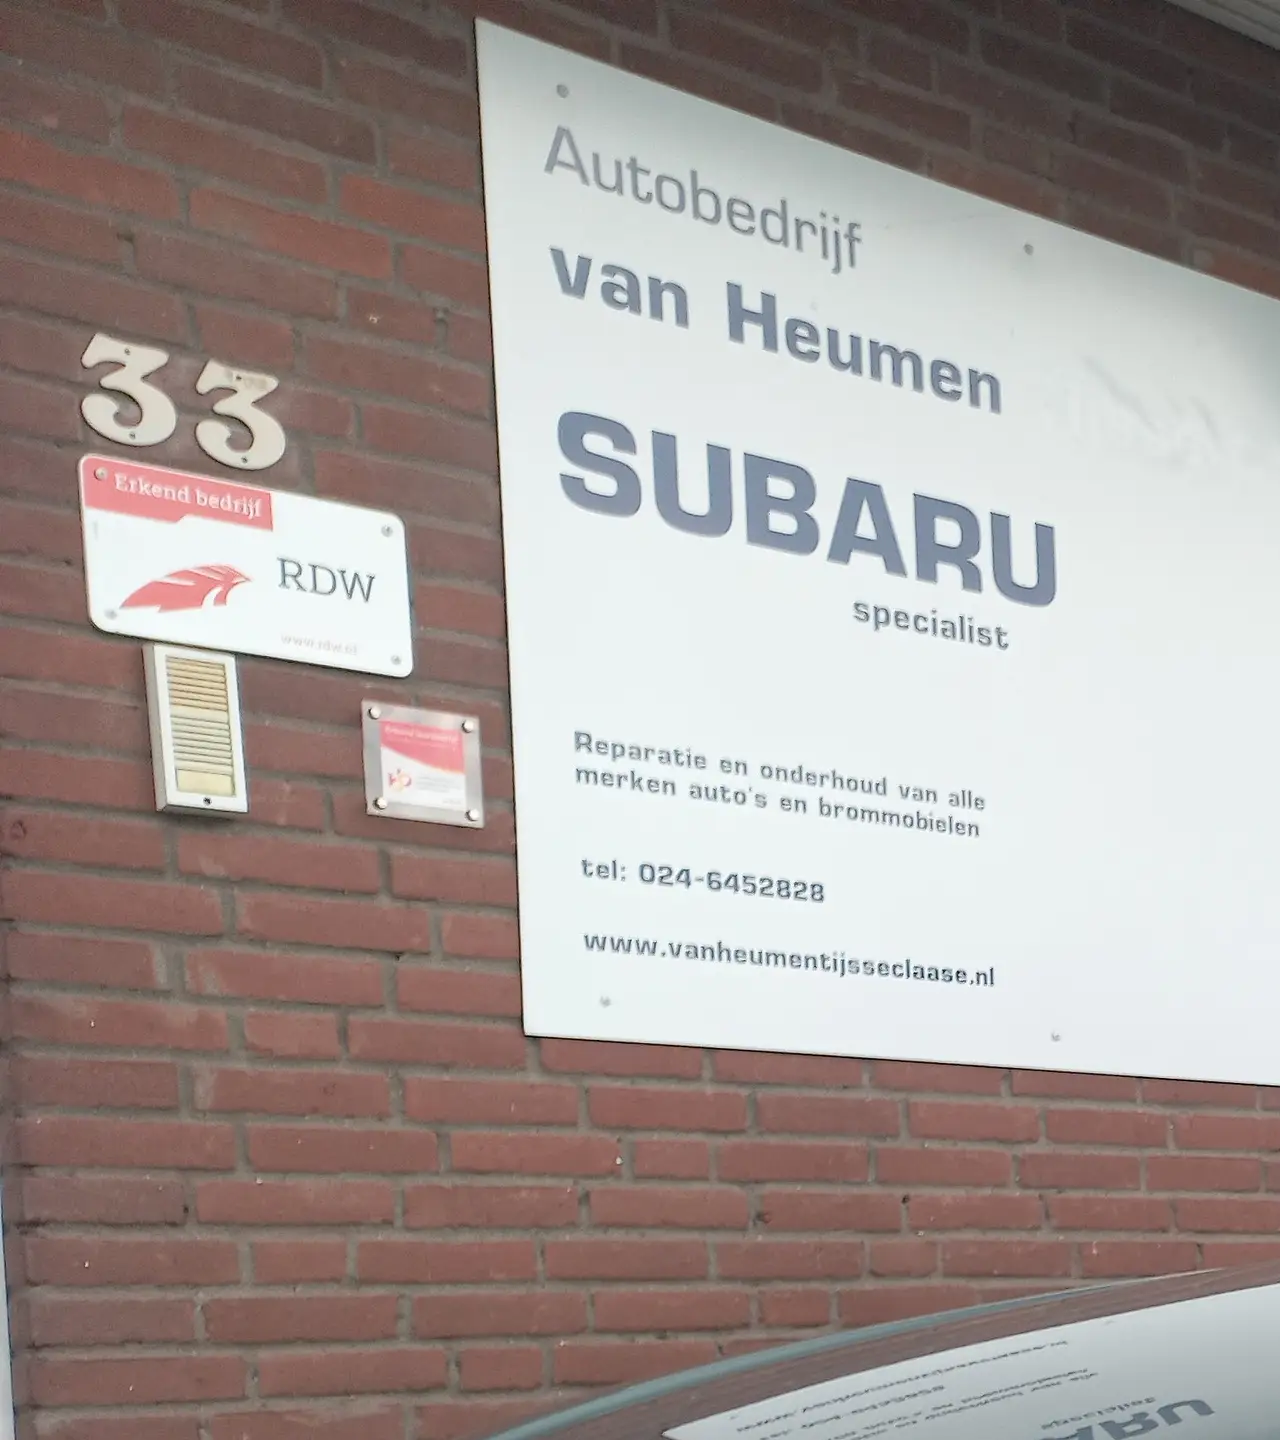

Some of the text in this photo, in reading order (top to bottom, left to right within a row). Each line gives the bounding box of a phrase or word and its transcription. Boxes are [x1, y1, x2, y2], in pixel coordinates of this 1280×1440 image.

[543, 125, 862, 274] Autobedrijf
[549, 246, 1002, 414] van Heumen
[81, 333, 286, 470] 33
[114, 472, 263, 519] Erkend bedrijf
[556, 410, 1057, 608] SUBARU
[276, 557, 376, 603] RDW
[853, 599, 1009, 650] specialist
[573, 731, 986, 811] Reparatie en onderhoud van alle
[574, 765, 980, 838] merken auto's en brommobielen
[581, 857, 825, 903] tel: 024-6452828
[583, 931, 995, 987] www.vanheumentijsseclaase.nl
